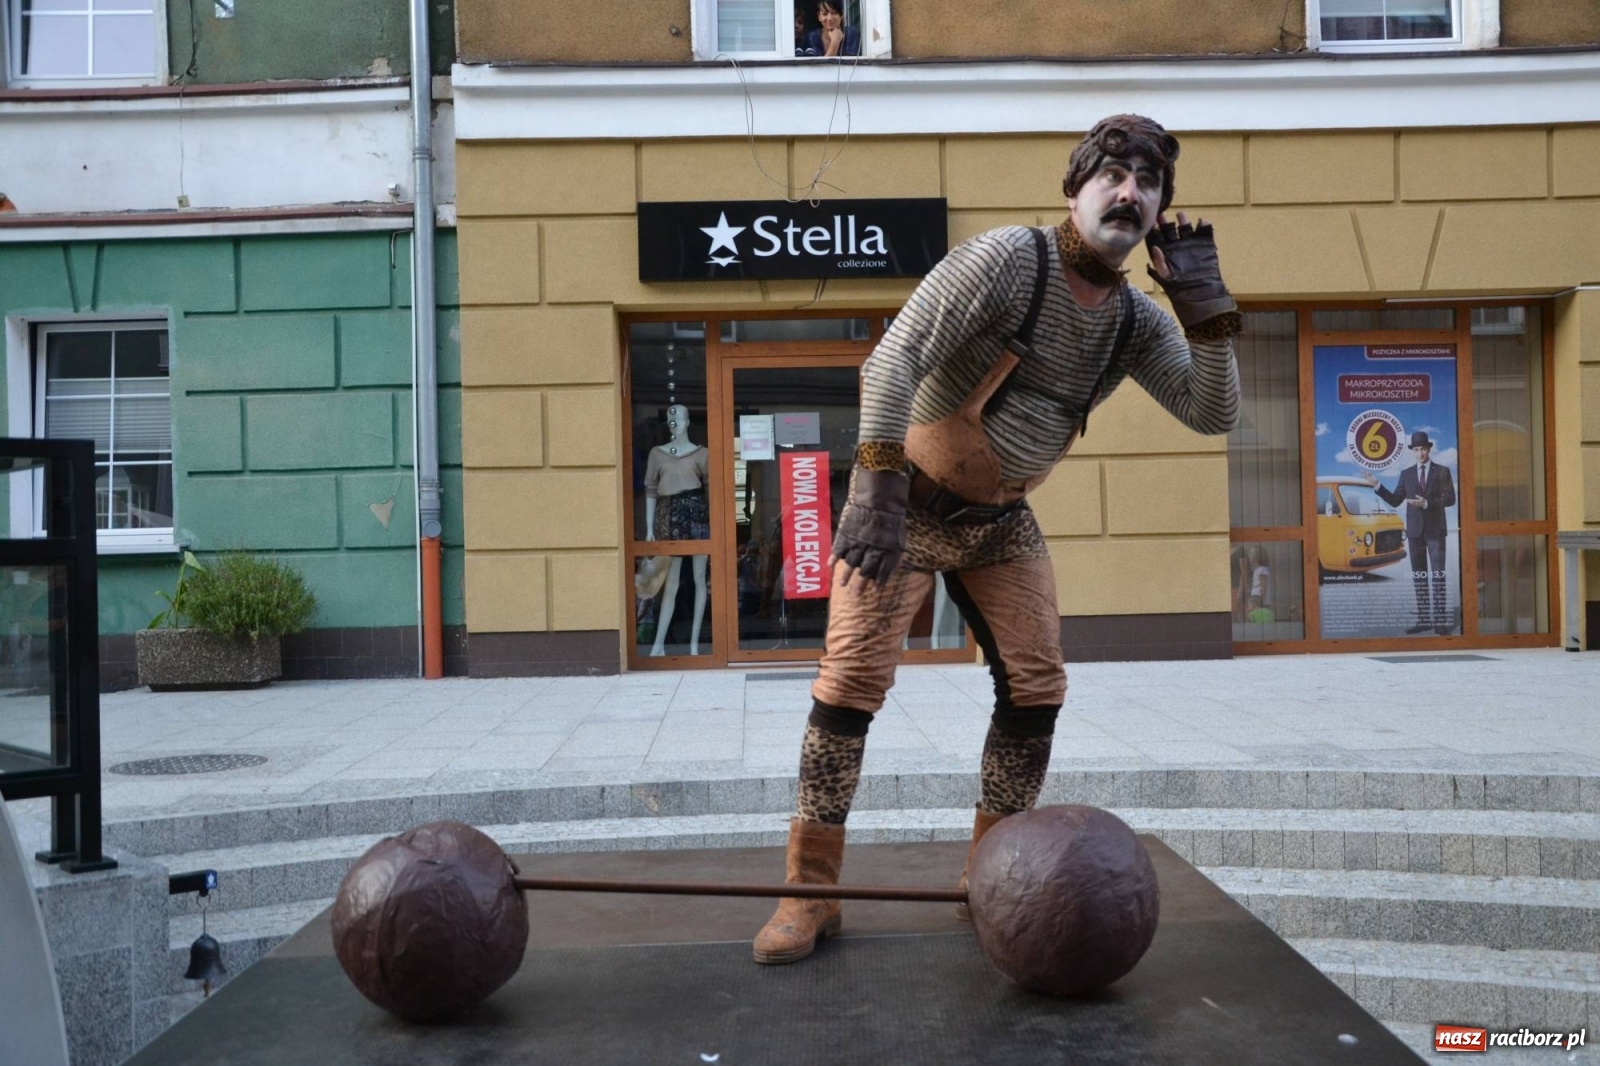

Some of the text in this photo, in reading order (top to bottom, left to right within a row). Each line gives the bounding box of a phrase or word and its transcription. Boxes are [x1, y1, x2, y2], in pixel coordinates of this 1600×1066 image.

[753, 214, 888, 257] Stella
[837, 260, 887, 268] collezione
[1345, 379, 1424, 388] MAKROPRZYGODA
[1350, 390, 1419, 398] MIKROKOSZTEM
[1362, 421, 1388, 459] 6
[792, 457, 818, 505] NOWA
[794, 509, 821, 593] KOLEKCJA
